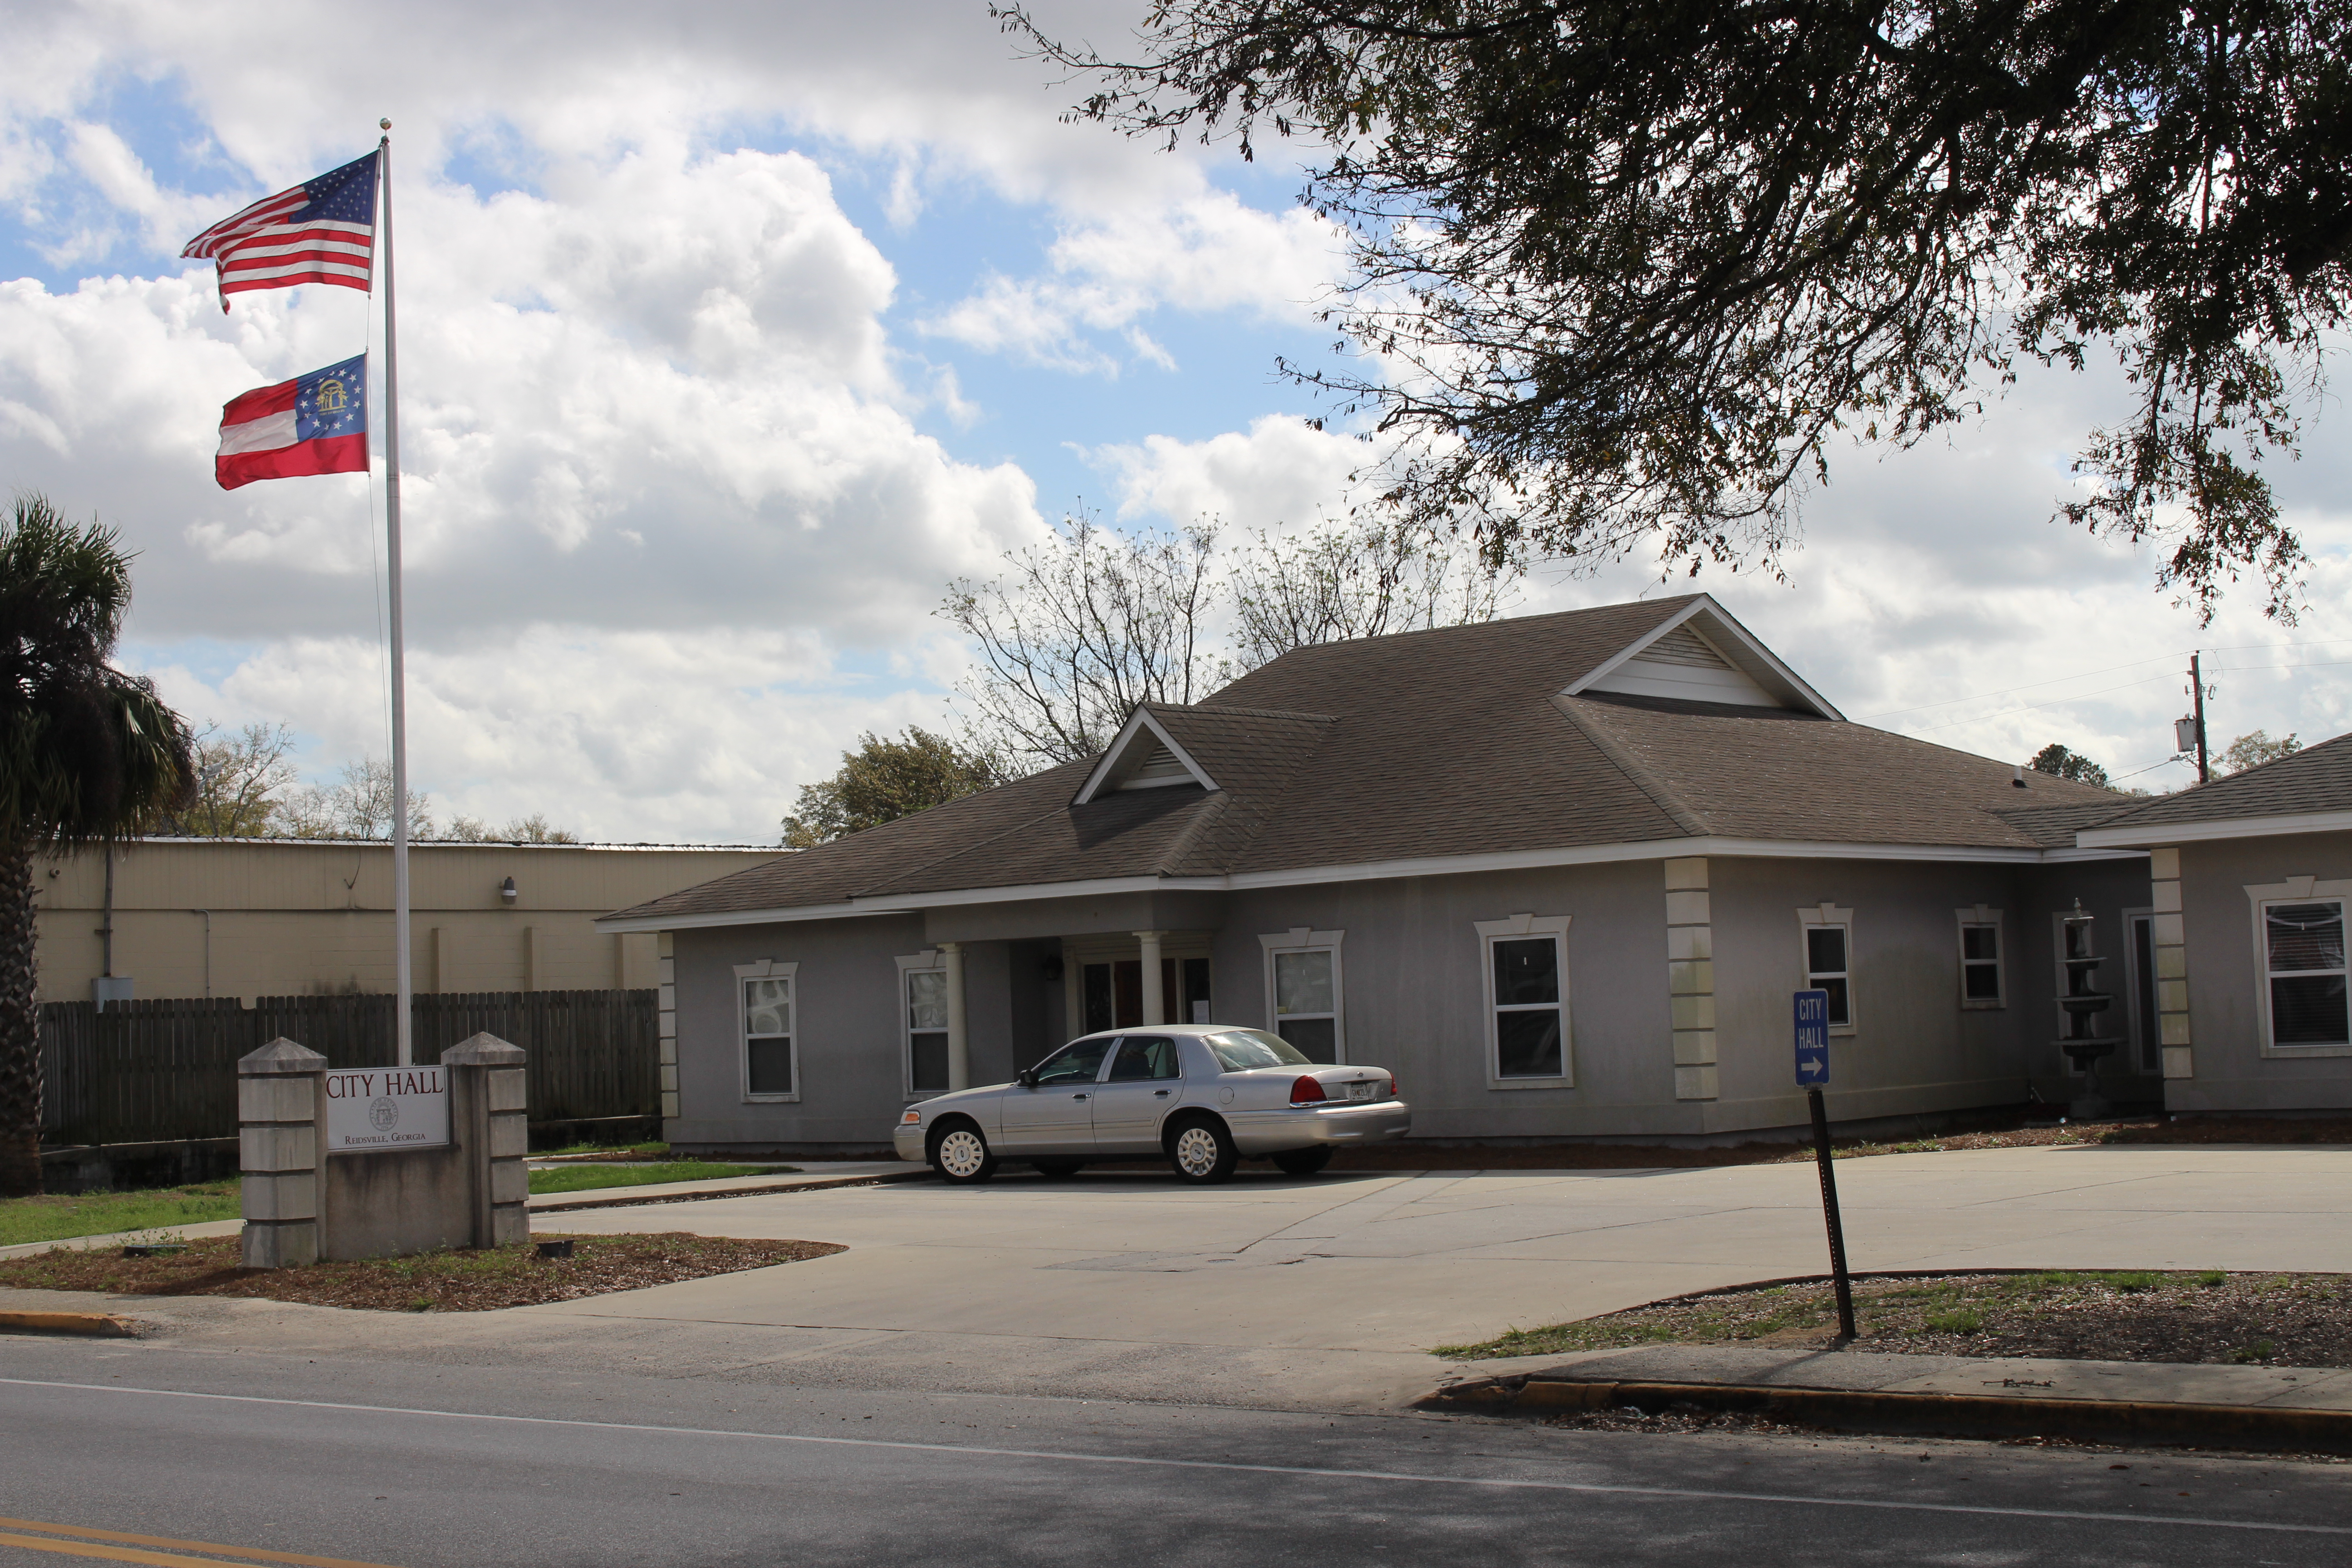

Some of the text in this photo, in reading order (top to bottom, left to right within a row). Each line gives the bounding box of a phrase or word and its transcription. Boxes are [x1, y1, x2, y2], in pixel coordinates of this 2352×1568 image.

[1799, 998, 1821, 1020] CITY
[1799, 1027, 1823, 1049] HALL
[326, 1071, 443, 1098] CITY HALL
